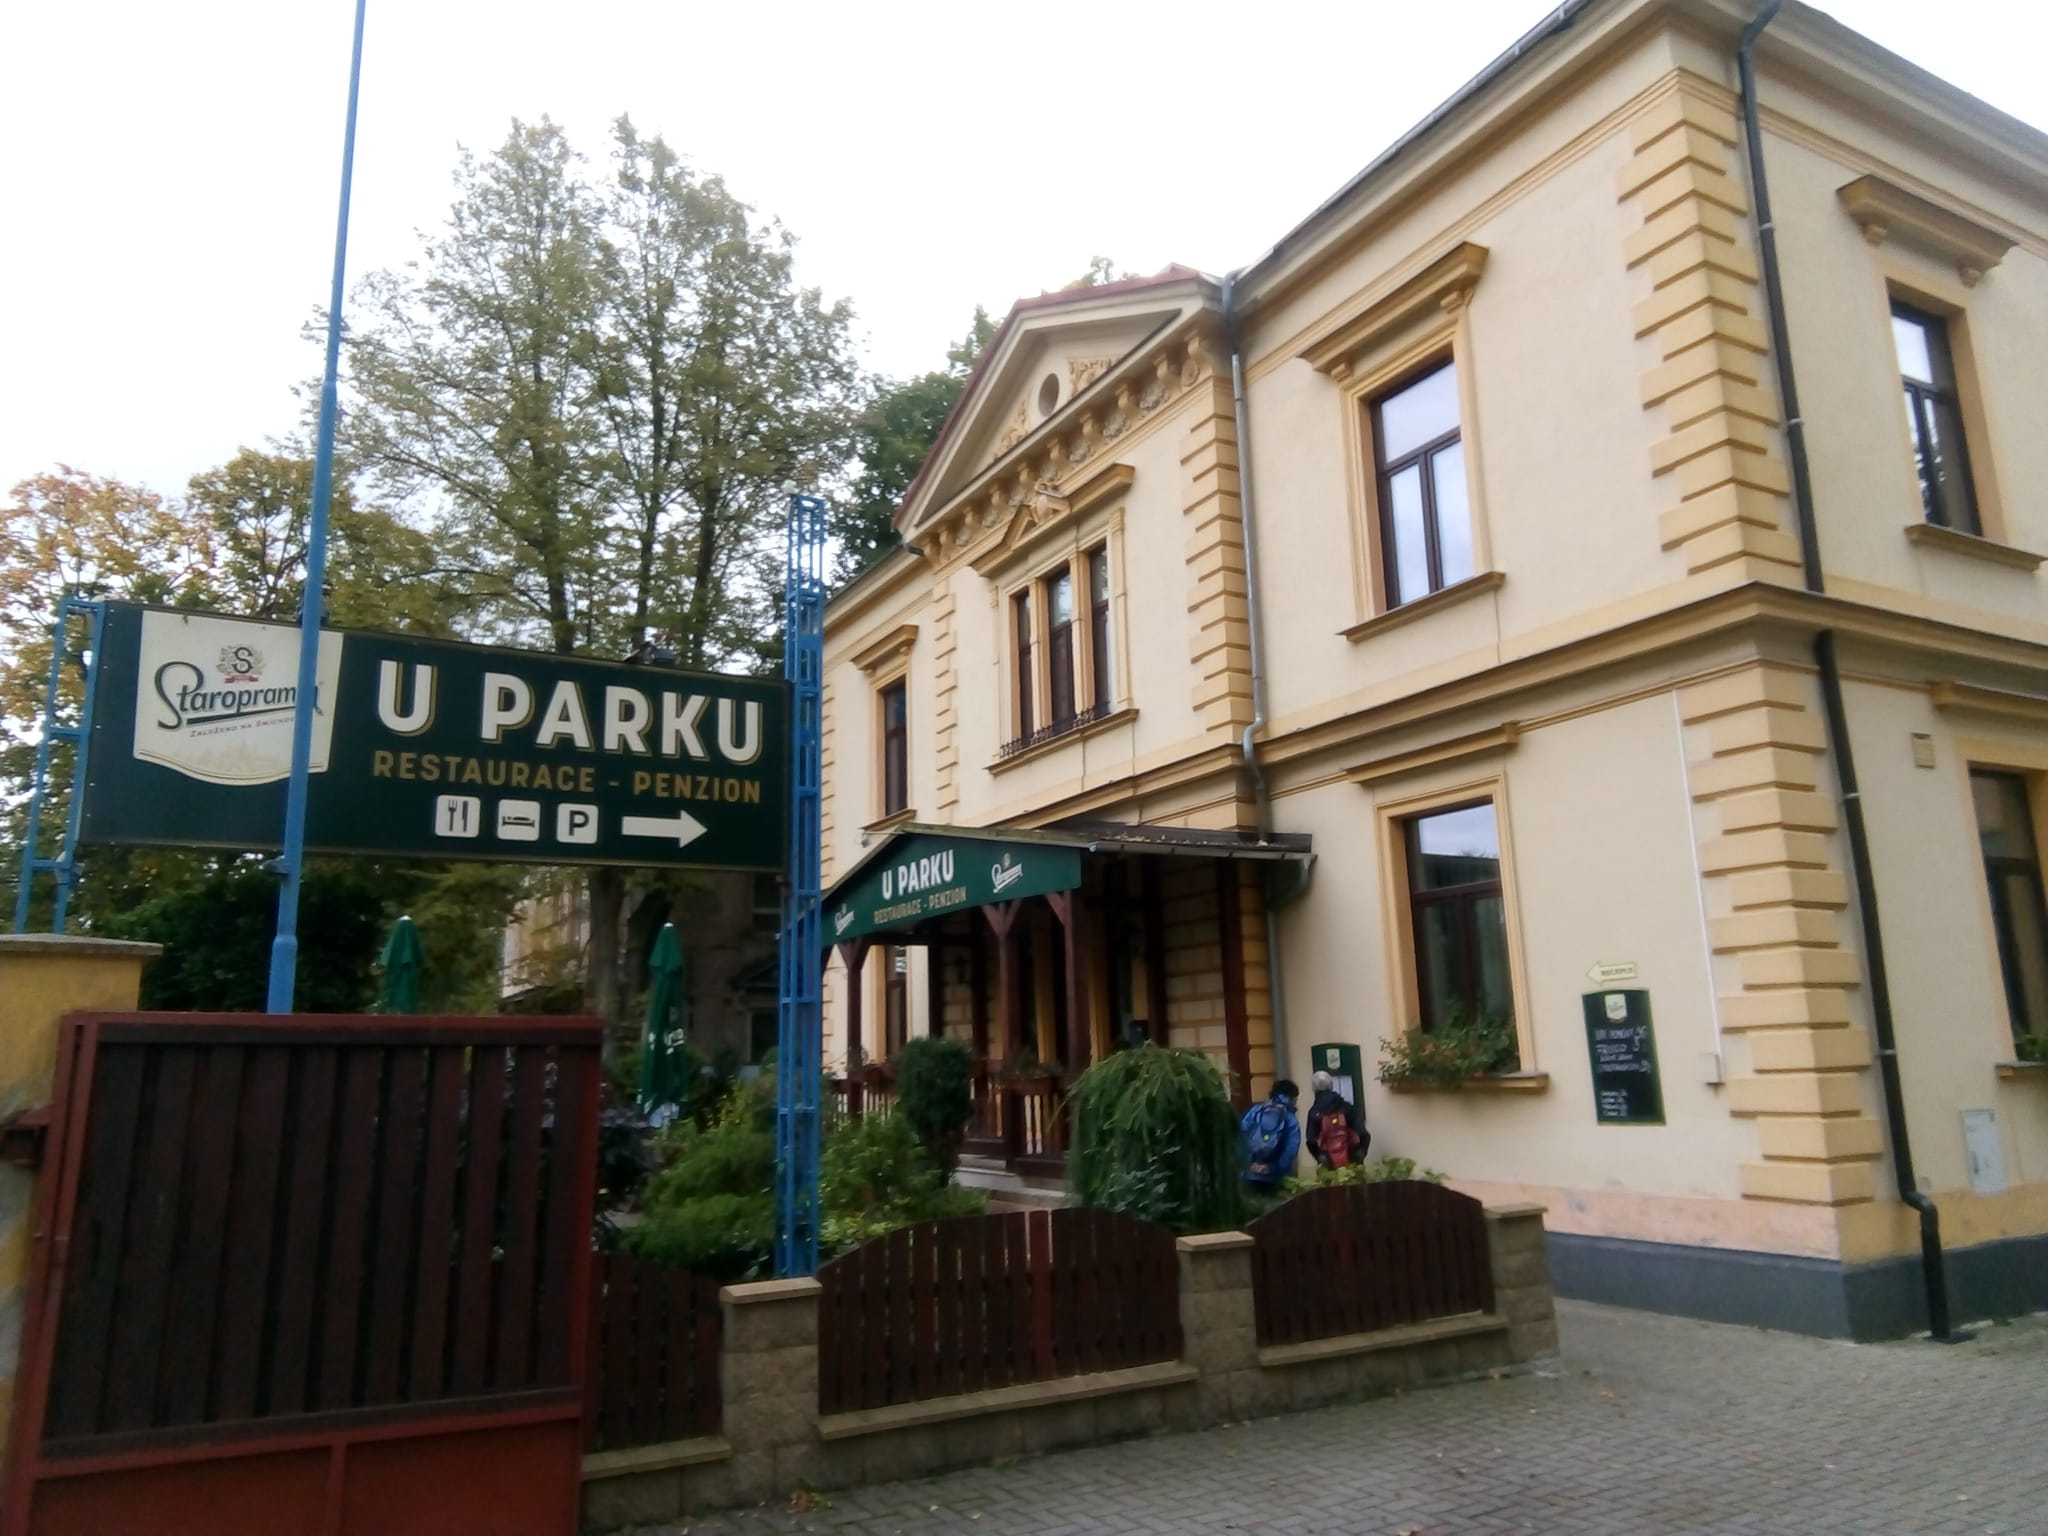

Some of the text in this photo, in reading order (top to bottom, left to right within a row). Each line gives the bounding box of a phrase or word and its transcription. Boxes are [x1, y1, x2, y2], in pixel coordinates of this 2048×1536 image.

[154, 661, 323, 730] Staropram
[378, 659, 764, 766] U PARKU
[373, 750, 596, 793] RESTAURACE
[632, 770, 761, 804] PENZION
[567, 809, 590, 837] P
[881, 869, 893, 901] U
[897, 848, 955, 897] PARKU
[873, 898, 922, 925] RESTAURACE
[928, 886, 967, 910] PENZION
